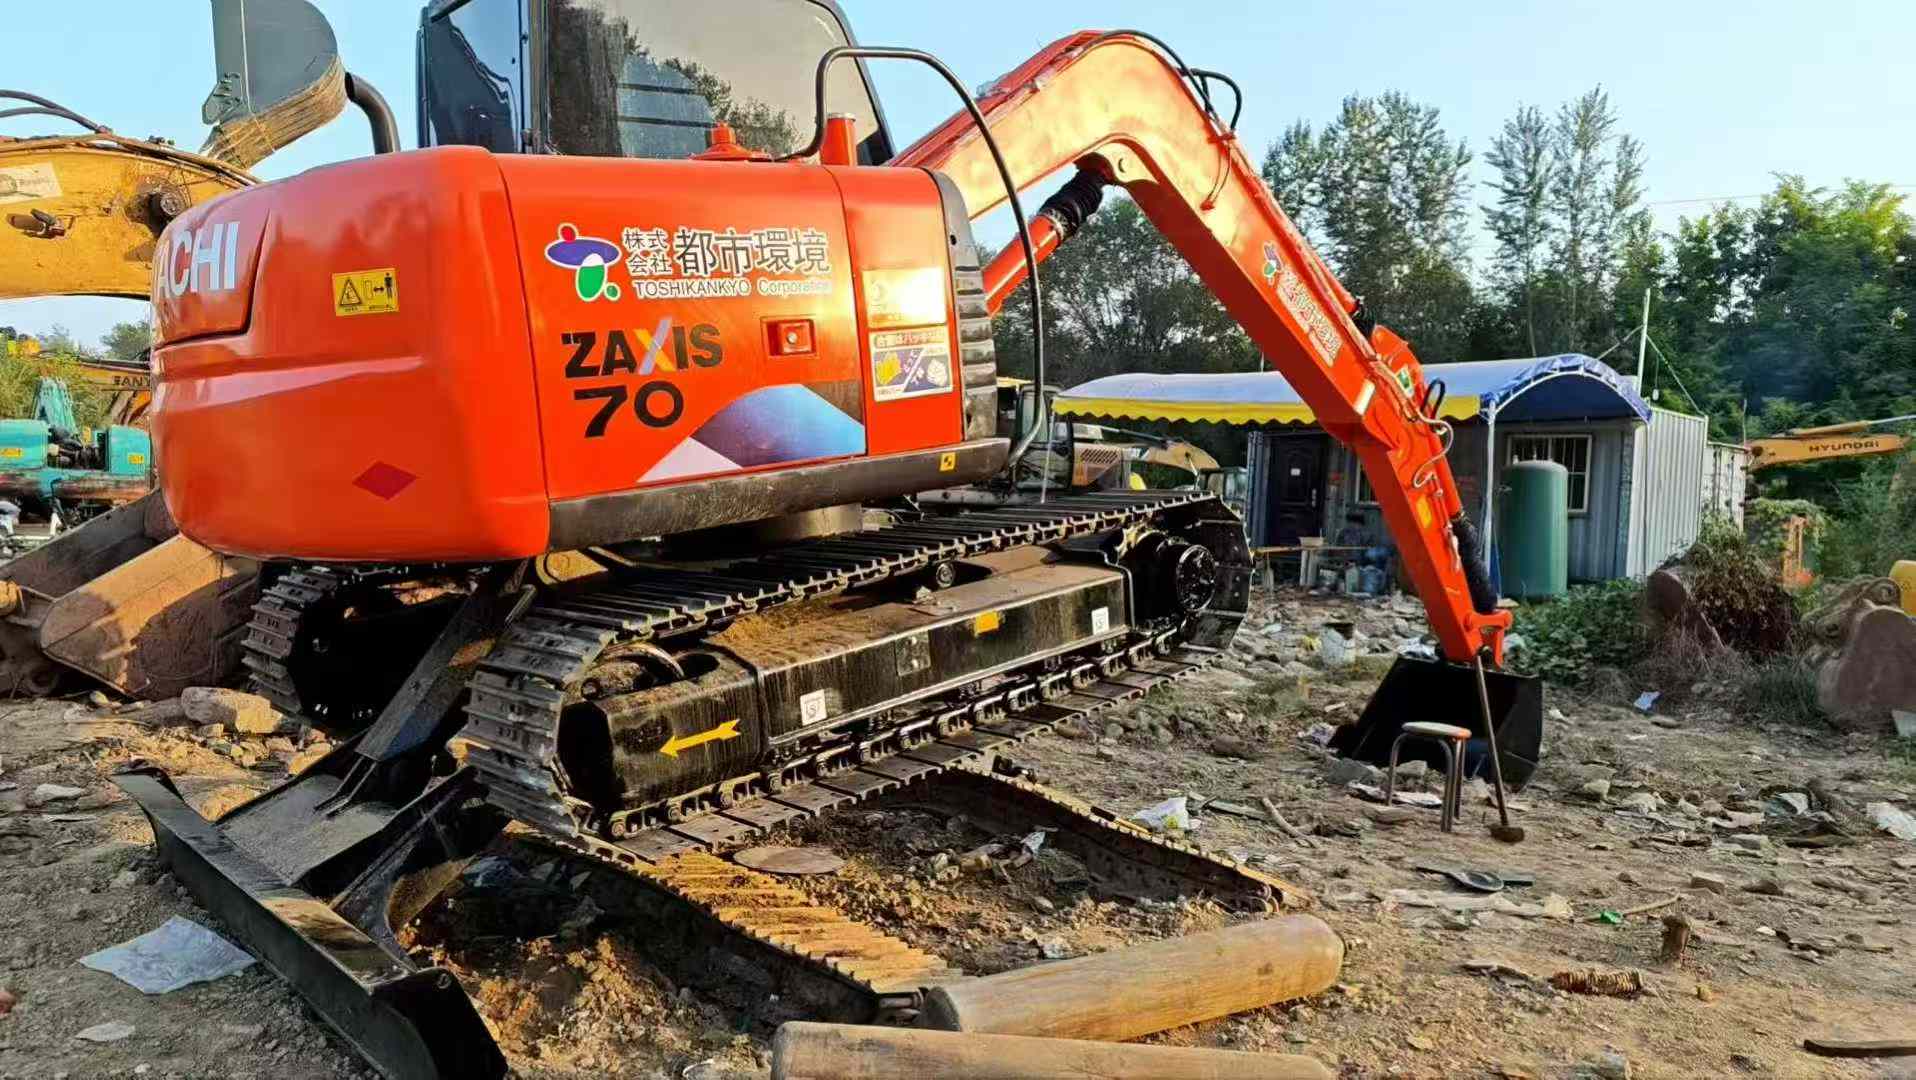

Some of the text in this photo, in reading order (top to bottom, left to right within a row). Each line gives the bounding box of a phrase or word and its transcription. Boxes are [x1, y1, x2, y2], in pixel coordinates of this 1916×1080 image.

[623, 230, 668, 250] 株式
[675, 228, 830, 275] 都市環境
[628, 253, 673, 275] 会社
[634, 278, 750, 298] TOSHIKANKYO
[561, 319, 724, 378] ZAXIS
[573, 380, 684, 438] 70
[1809, 440, 1880, 453] HYUNDAI
